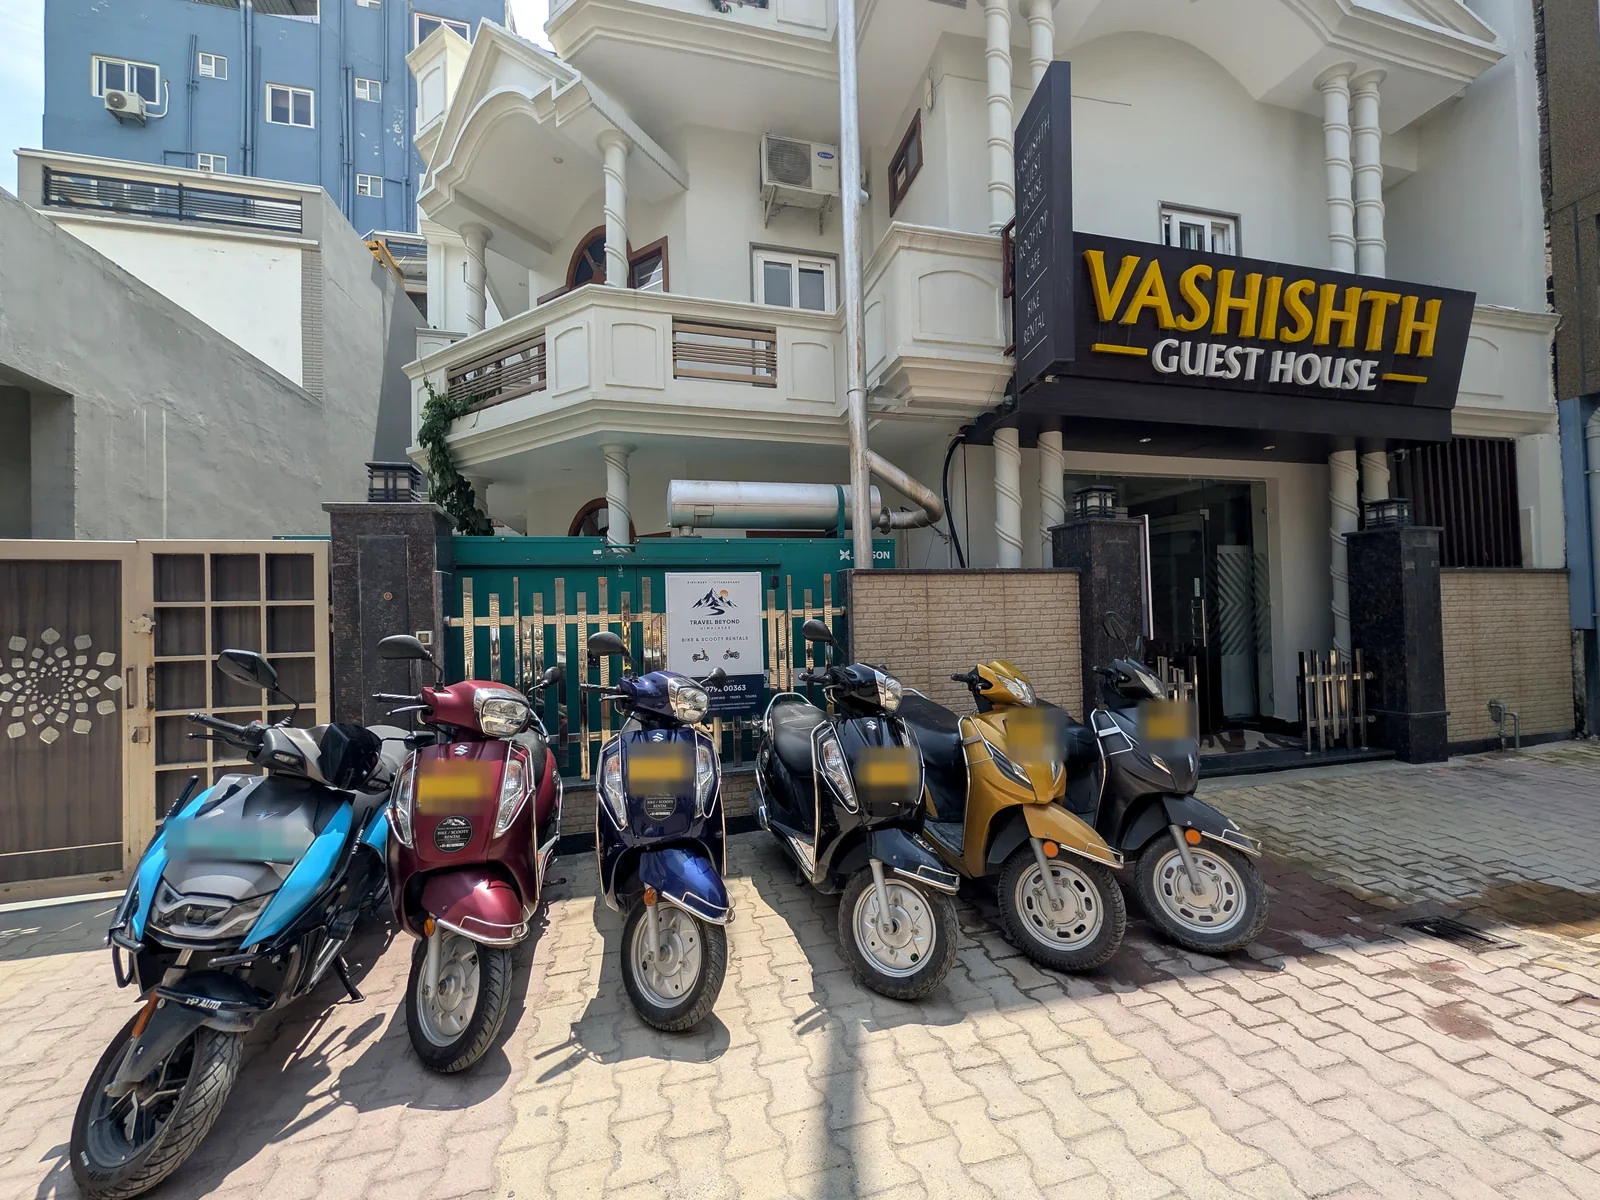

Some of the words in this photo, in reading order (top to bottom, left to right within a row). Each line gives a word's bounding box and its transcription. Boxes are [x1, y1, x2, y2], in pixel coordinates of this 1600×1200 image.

[1018, 209, 1049, 262] ROOFTOP
[1025, 247, 1041, 278] CAFE
[1027, 290, 1040, 318] BIKE
[1083, 249, 1442, 357] VASHISHTH
[1023, 311, 1046, 346] RENTAL
[1151, 338, 1265, 381] GUEST
[1268, 350, 1379, 391] HOUSE
[723, 684, 747, 692] 00363
[198, 999, 222, 1010] AUTO
